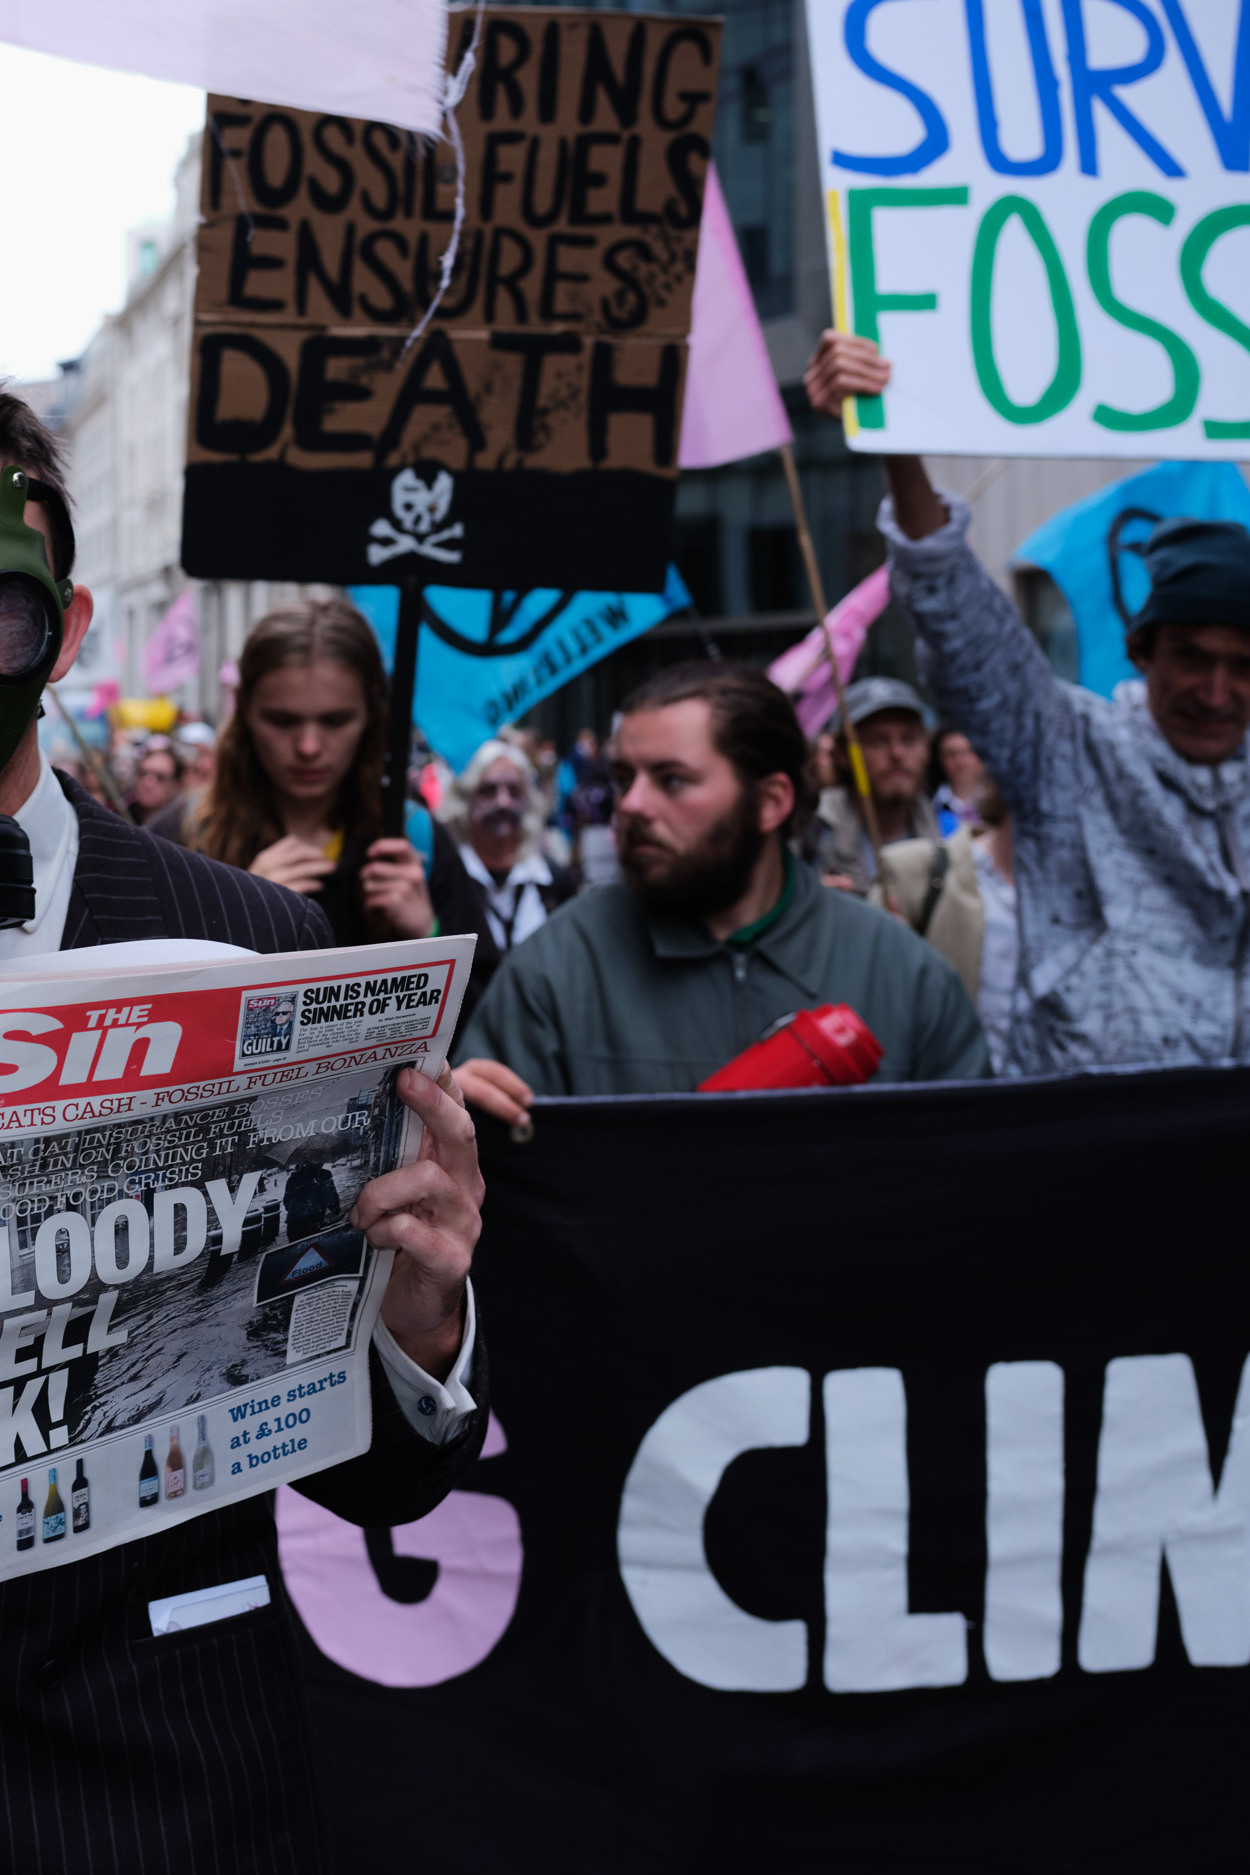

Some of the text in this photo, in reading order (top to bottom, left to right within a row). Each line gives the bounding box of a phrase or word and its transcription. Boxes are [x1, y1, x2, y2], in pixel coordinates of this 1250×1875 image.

[831, 0, 1250, 178] SURV
[208, 111, 712, 231] FOSSIL FUELS
[225, 214, 650, 331] ENSURES
[848, 185, 1250, 441] FOSS
[194, 330, 682, 469] DEATH
[86, 1004, 153, 1029] THE
[248, 998, 275, 1008] Sun
[300, 1000, 368, 1026] SINNER
[368, 996, 392, 1016] OF
[394, 988, 442, 1010] YEAR
[303, 972, 429, 1006] SUN IS NAMED
[243, 1035, 290, 1055] GUILTY
[62, 1096, 136, 1123] CASH
[151, 1079, 240, 1108] FOSSIL
[244, 1066, 309, 1090] FUEL
[312, 1041, 432, 1077] BONANZA
[28, 1137, 79, 1159] CAT
[83, 1107, 228, 1149] INSURANCE
[234, 1086, 323, 1117] BOSSES
[48, 1153, 74, 1173] IN
[79, 1144, 115, 1165] ON
[118, 1130, 204, 1158] FOSSIL
[208, 1109, 284, 1137] FUELS
[108, 1138, 210, 1177] COINING
[212, 1135, 238, 1156] IT
[246, 1119, 317, 1149] FROM
[321, 1109, 371, 1134] OUR
[53, 1178, 120, 1210] FOOD
[123, 1162, 203, 1194] CRISIS
[291, 1262, 323, 1278] Flood
[228, 1369, 348, 1423] Wine starts
[230, 1407, 311, 1450] at £100
[230, 1436, 309, 1476] a bottle
[617, 1350, 1250, 1694] CLIM
